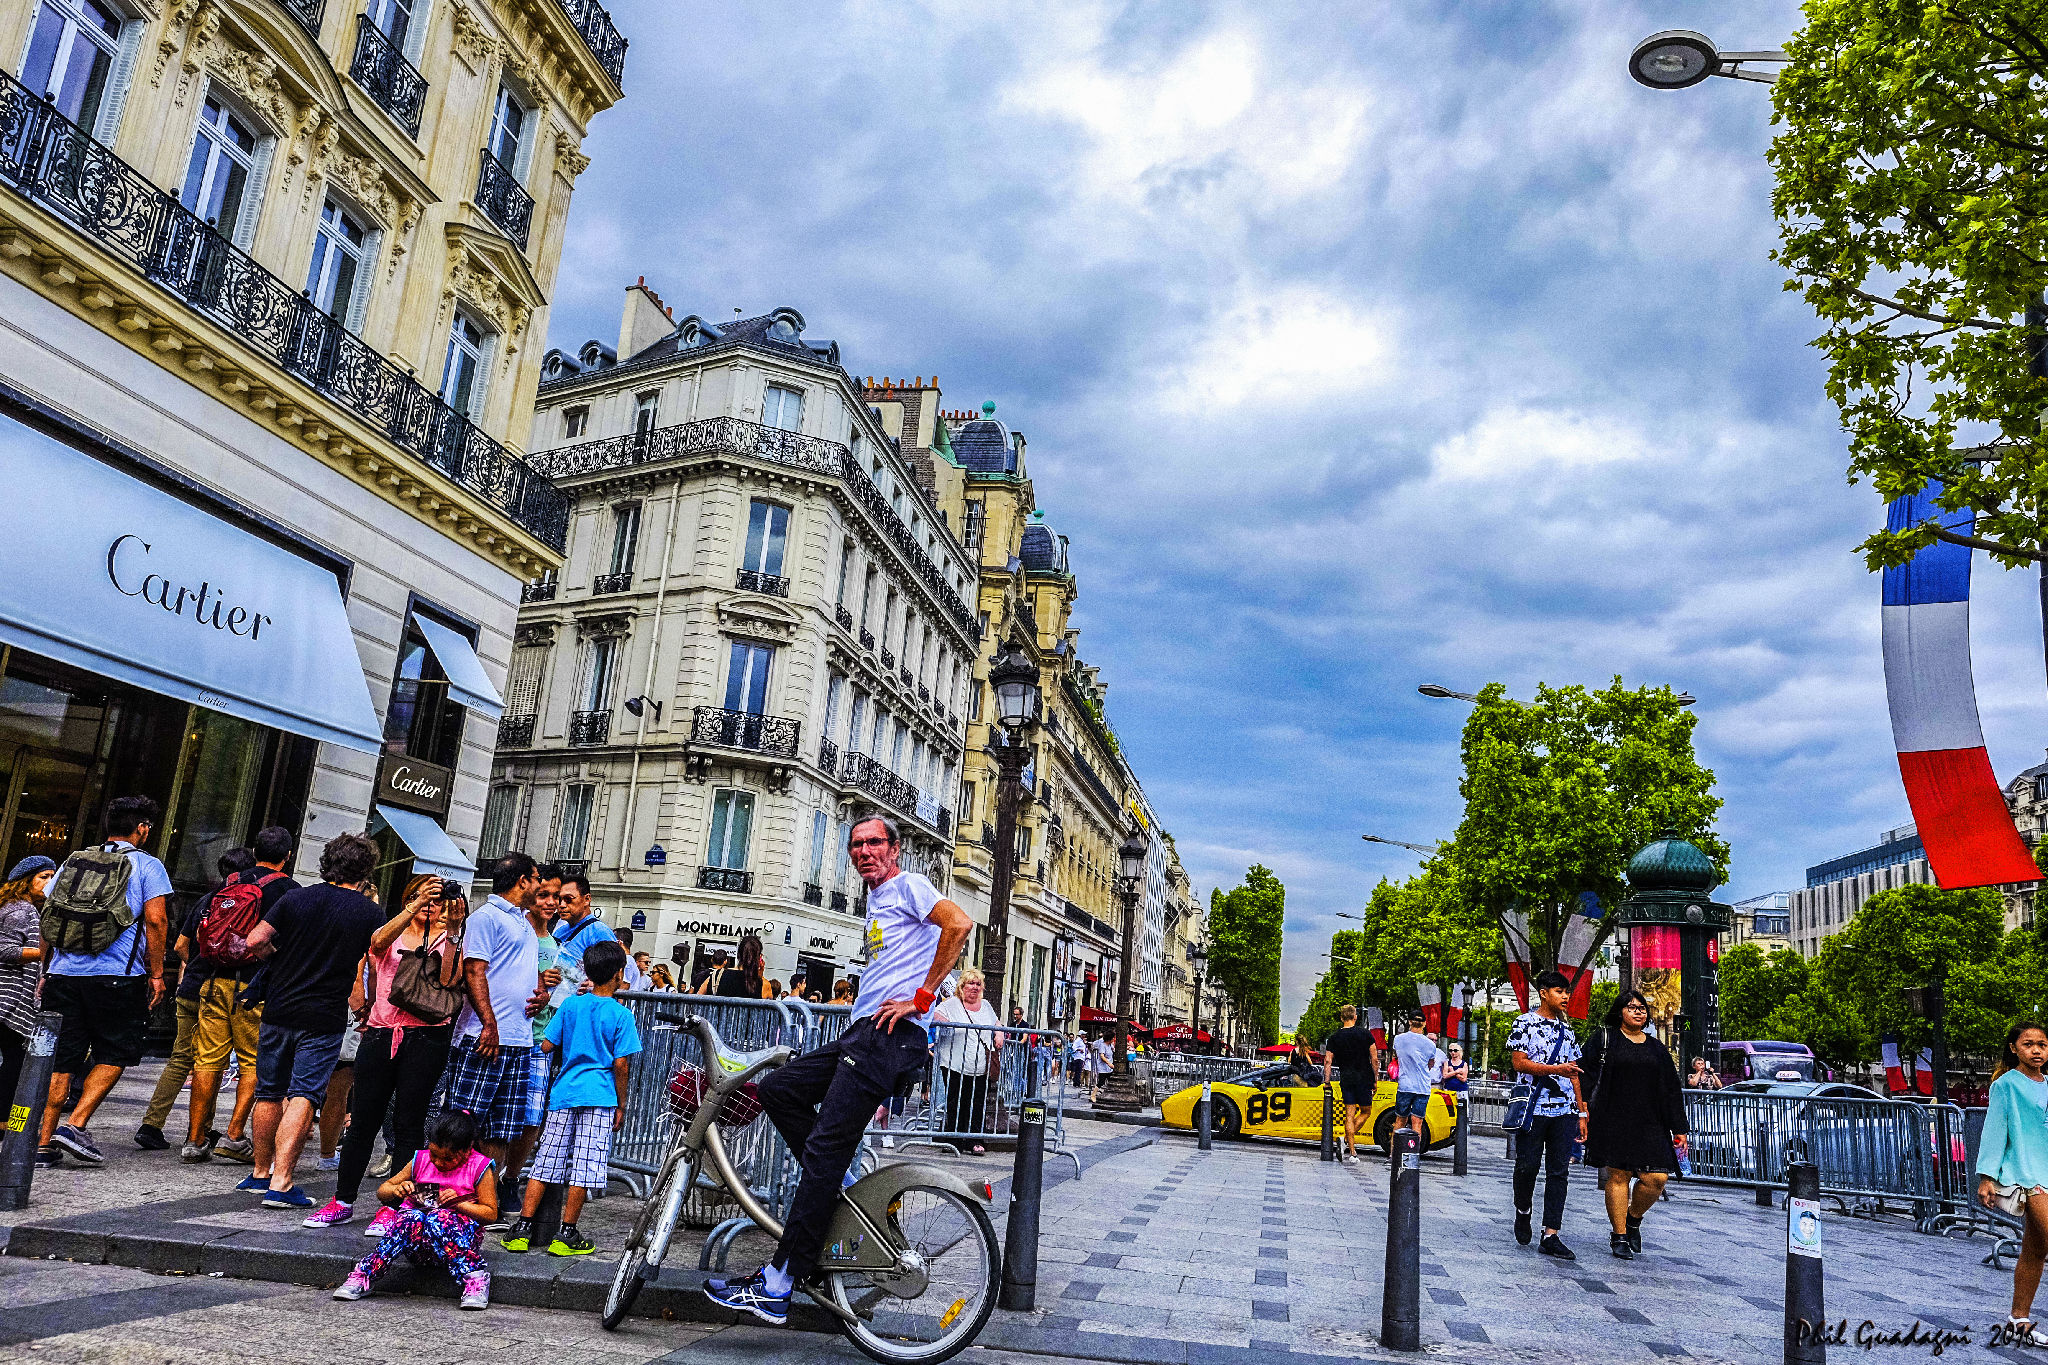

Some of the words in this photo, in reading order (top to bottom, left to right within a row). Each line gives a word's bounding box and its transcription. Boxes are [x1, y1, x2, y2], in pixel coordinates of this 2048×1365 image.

[107, 534, 272, 641] Cartier
[197, 690, 230, 709] Cartier
[391, 766, 441, 799] Cartier
[677, 919, 763, 937] MONTBLANC
[1247, 1091, 1292, 1126] 89
